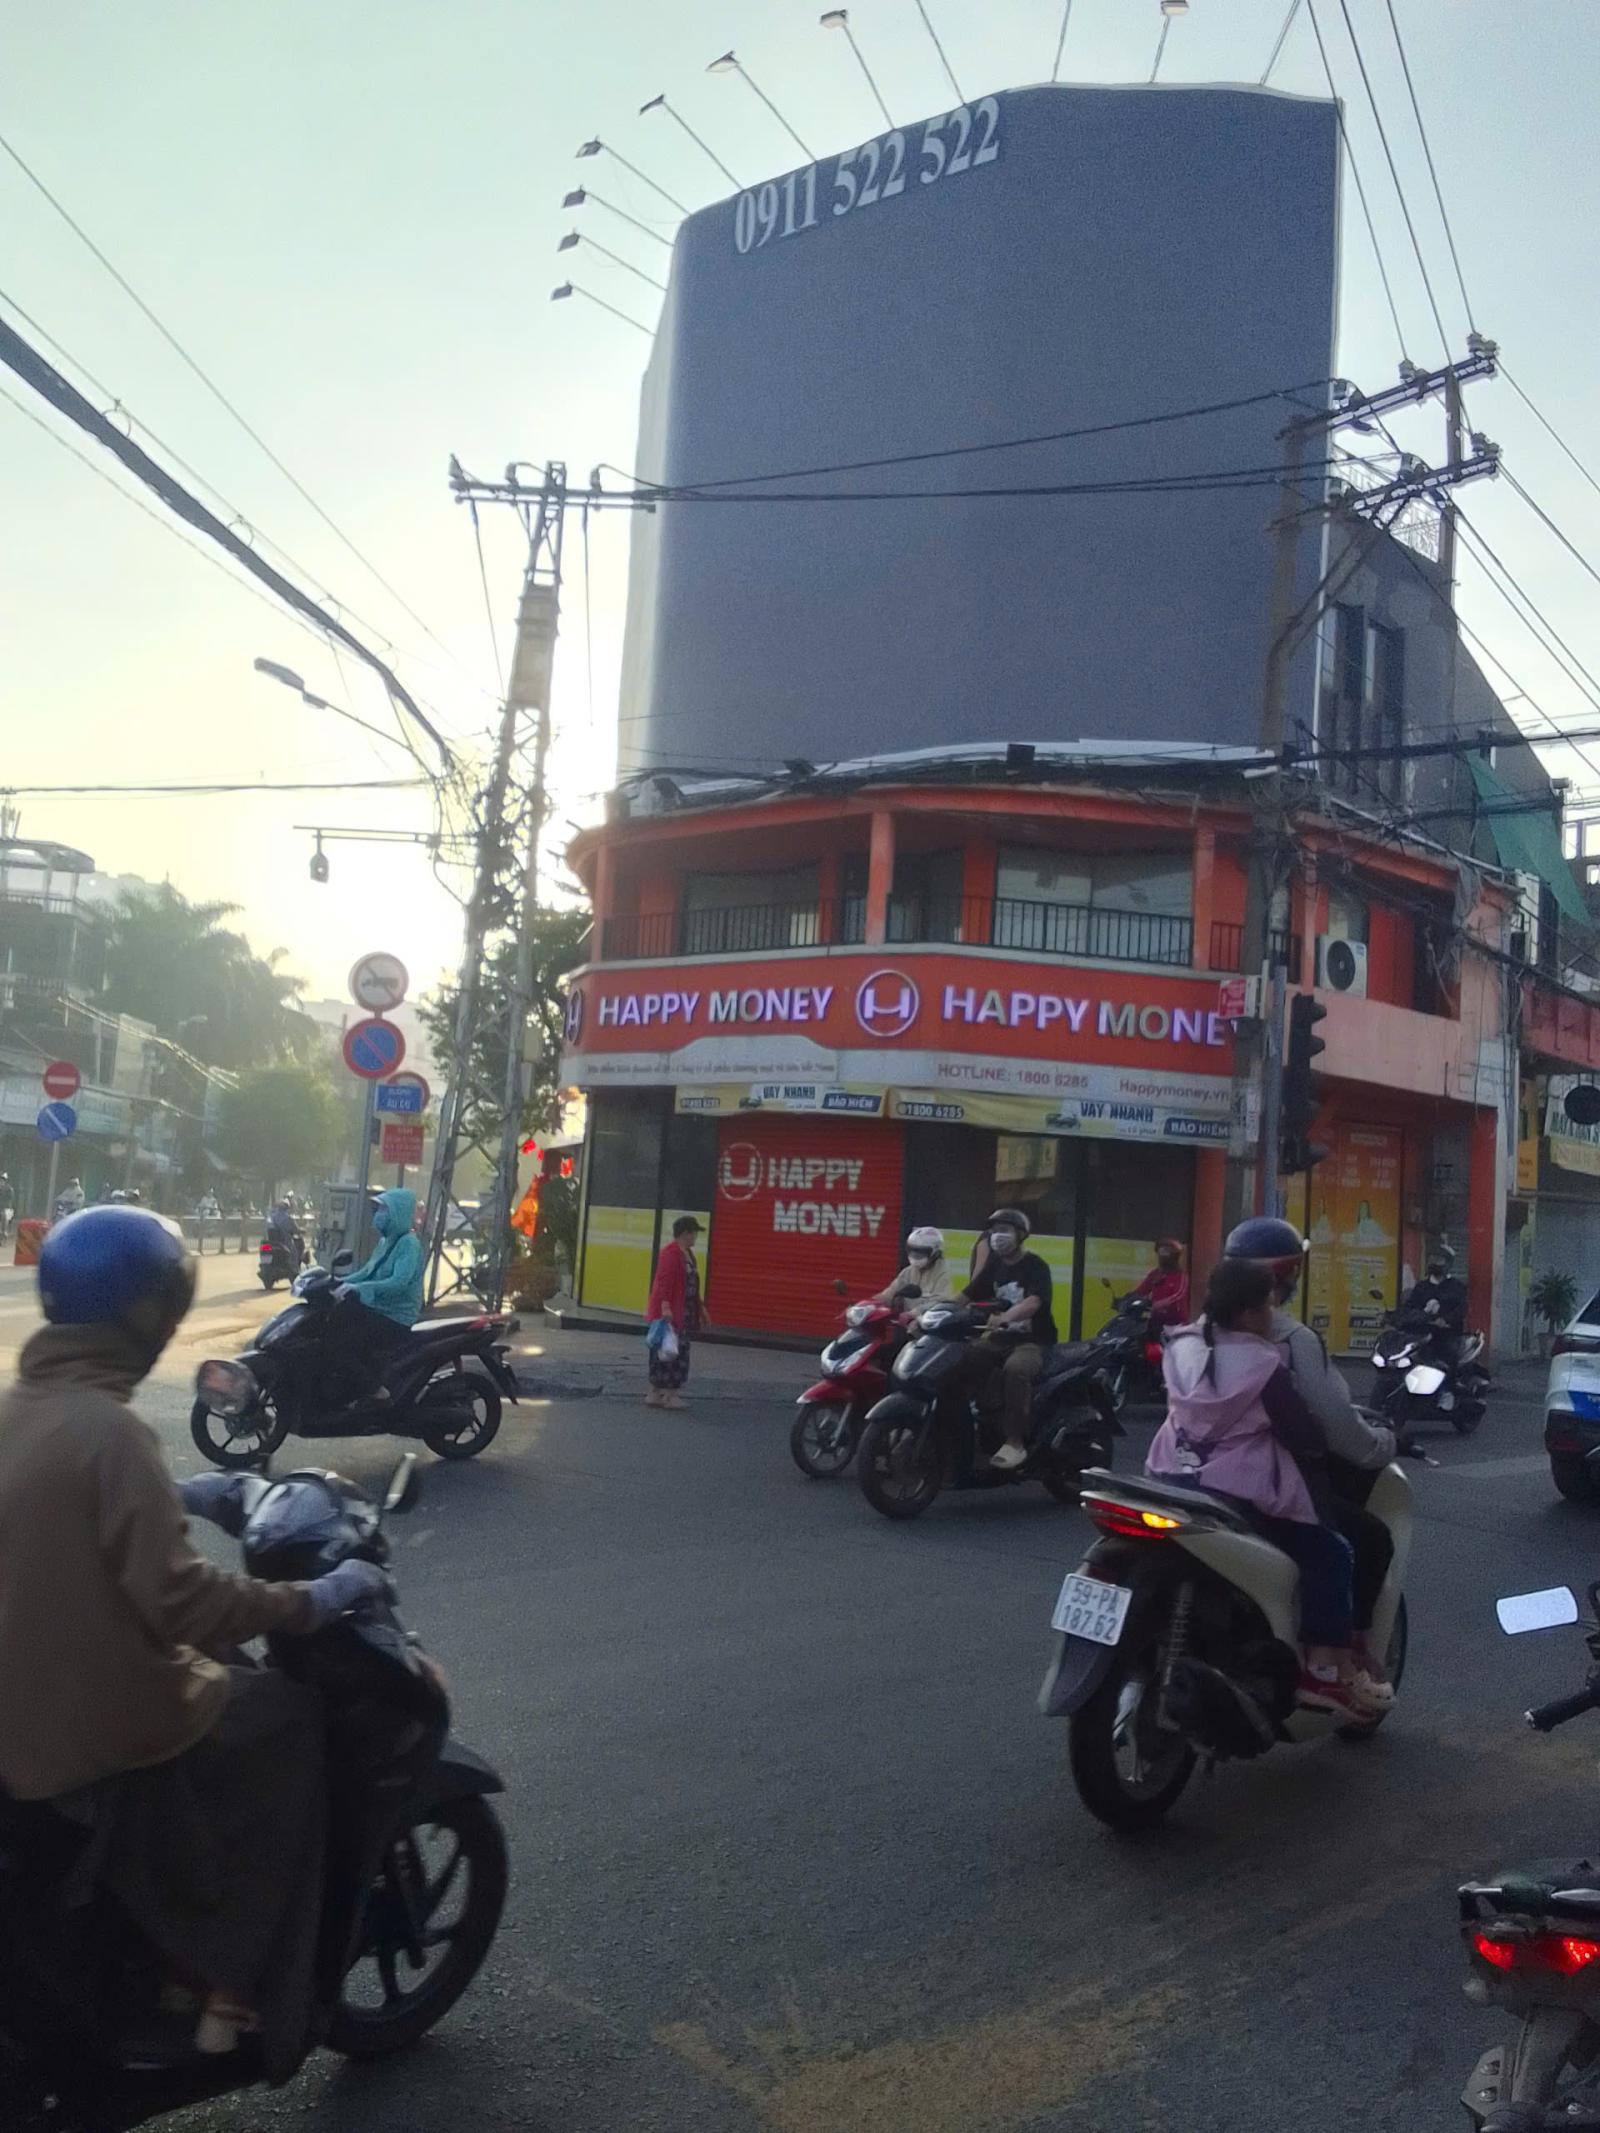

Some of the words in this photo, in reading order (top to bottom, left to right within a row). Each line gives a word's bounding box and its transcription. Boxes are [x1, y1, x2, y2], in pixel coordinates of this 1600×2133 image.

[735, 164, 818, 254] 0911
[832, 132, 906, 216] 522
[920, 97, 1000, 184] 522
[598, 990, 699, 1027] HAPPY
[708, 985, 834, 1023] MONEY
[943, 984, 1090, 1033] HAPPY
[1097, 1001, 1238, 1046] MONE
[938, 1063, 1011, 1082] HOTLINE:
[1017, 1069, 1050, 1085] 1800
[1080, 1102, 1105, 1118] VAY
[1110, 1103, 1153, 1123] NHANH
[767, 1157, 864, 1191] HAPPY
[773, 1200, 886, 1238] MONEY
